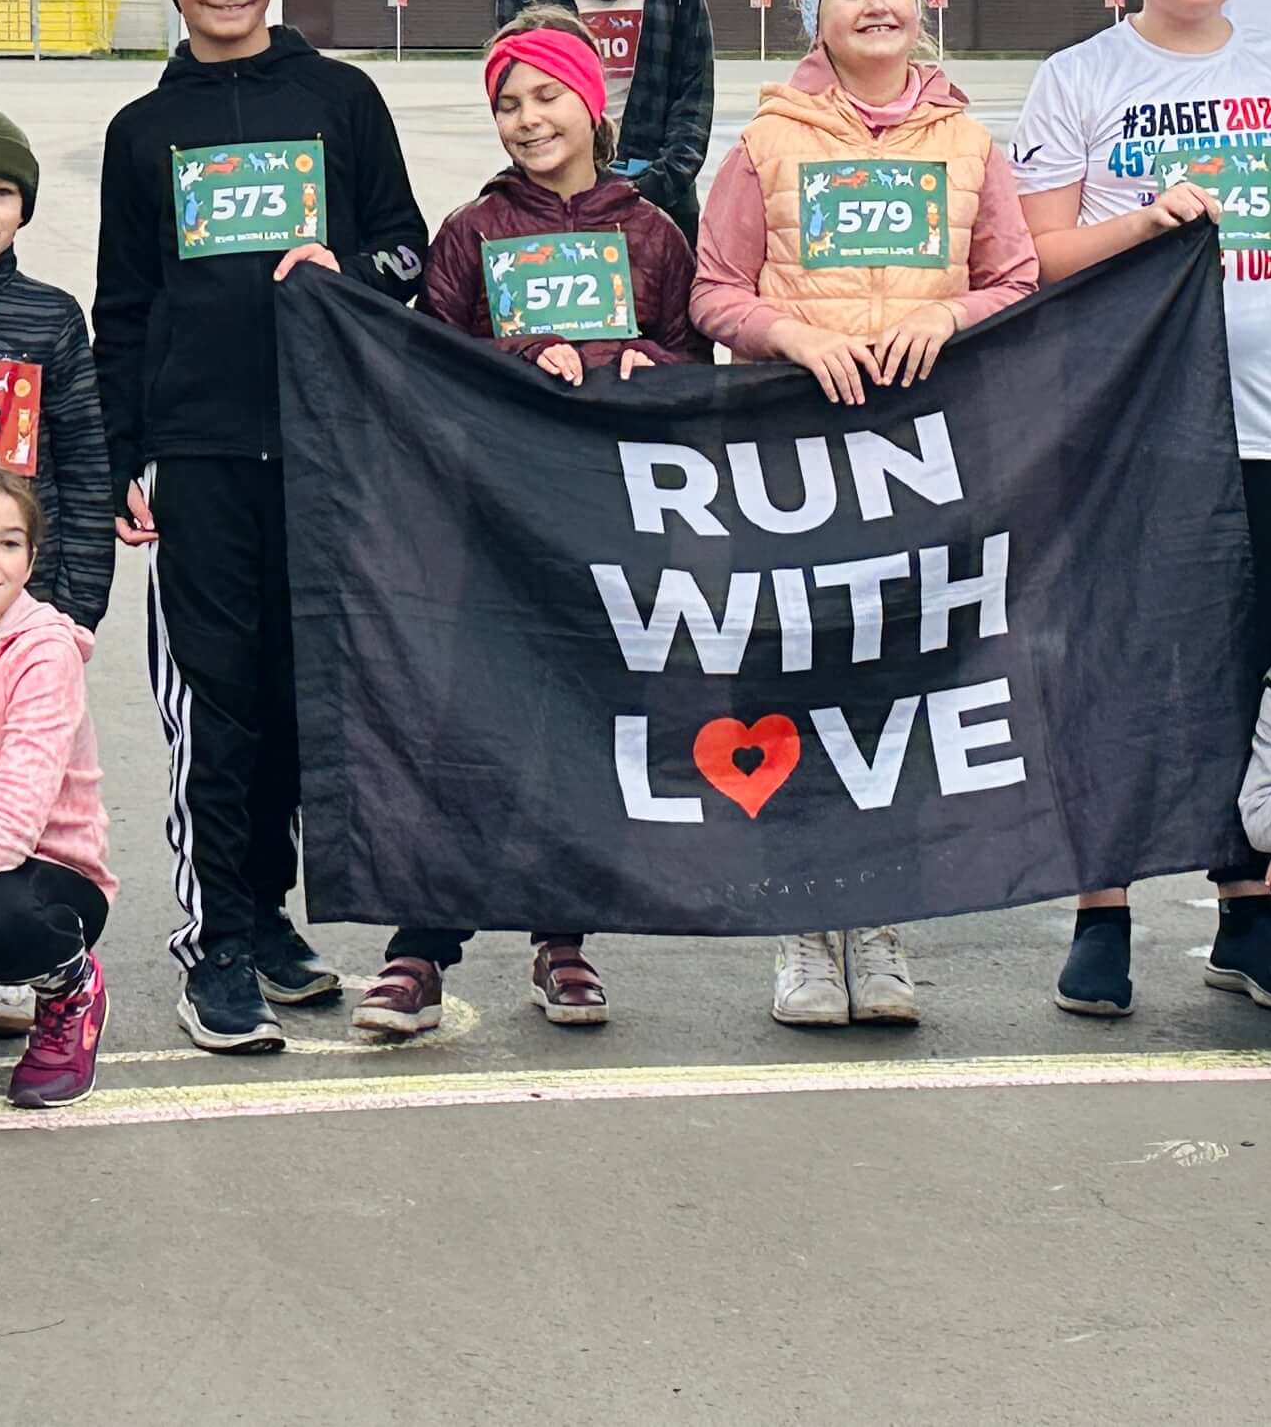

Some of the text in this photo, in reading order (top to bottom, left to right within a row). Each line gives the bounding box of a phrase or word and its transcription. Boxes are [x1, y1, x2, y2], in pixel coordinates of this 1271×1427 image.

[600, 37, 629, 59] 10
[211, 184, 287, 220] 573
[836, 200, 913, 234] 579
[1207, 185, 1271, 218] 45
[526, 274, 601, 311] 572
[617, 411, 964, 536] RUN
[589, 531, 1010, 675] WITH
